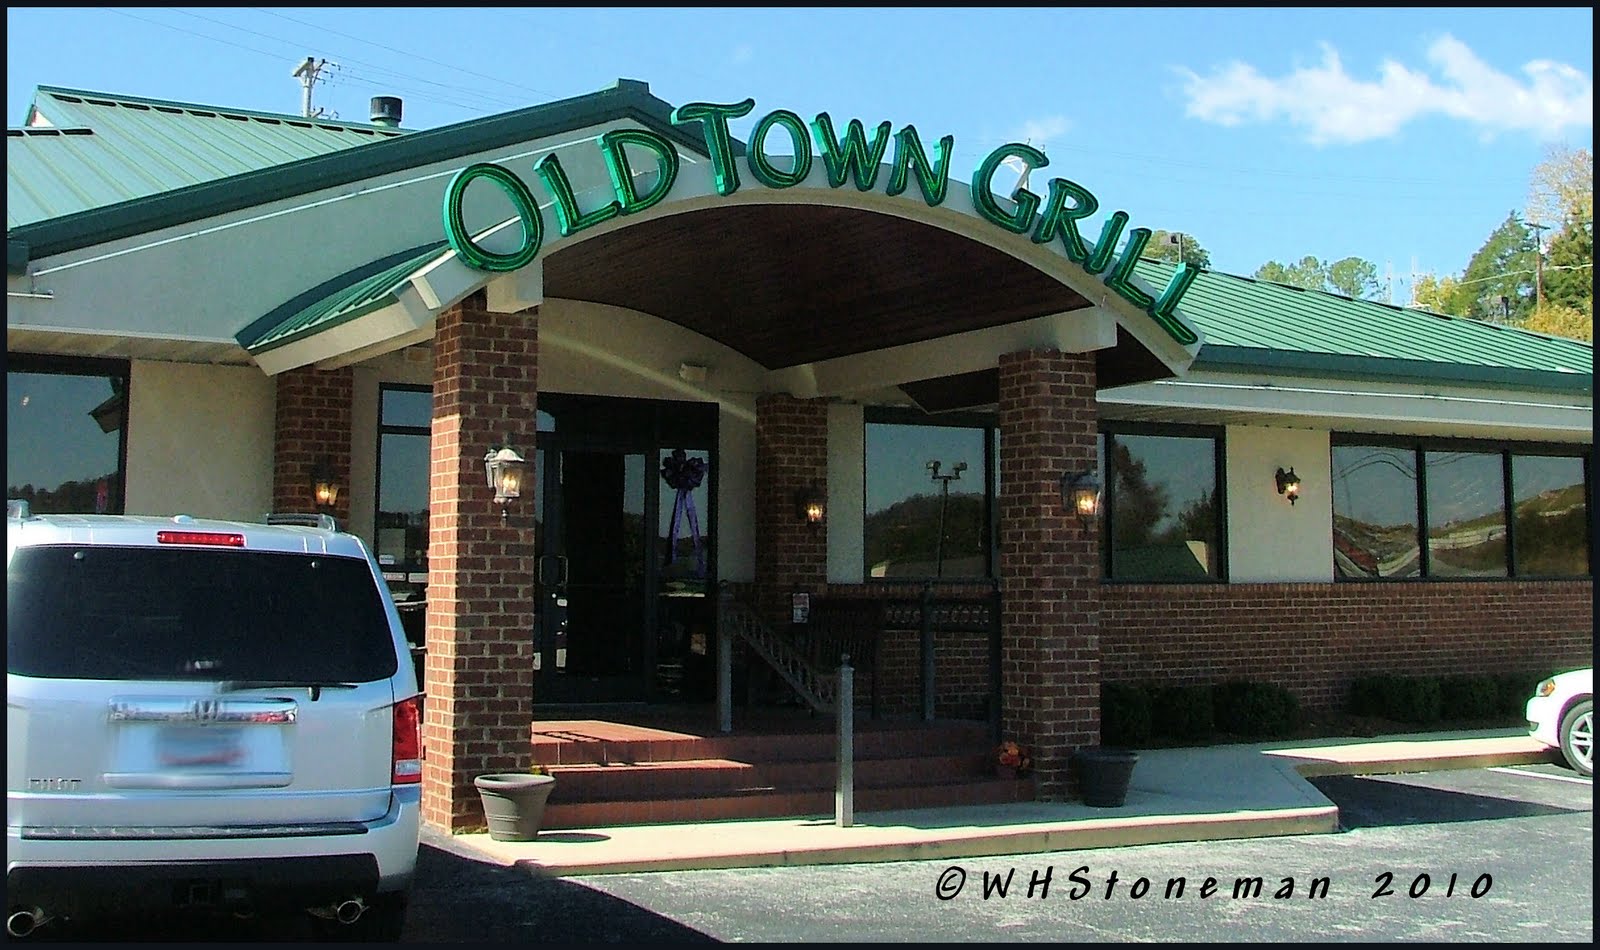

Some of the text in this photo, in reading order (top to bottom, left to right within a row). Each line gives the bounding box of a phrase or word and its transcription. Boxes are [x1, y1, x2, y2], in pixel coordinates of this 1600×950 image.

[443, 98, 1200, 345] OLD TOWN GRILL
